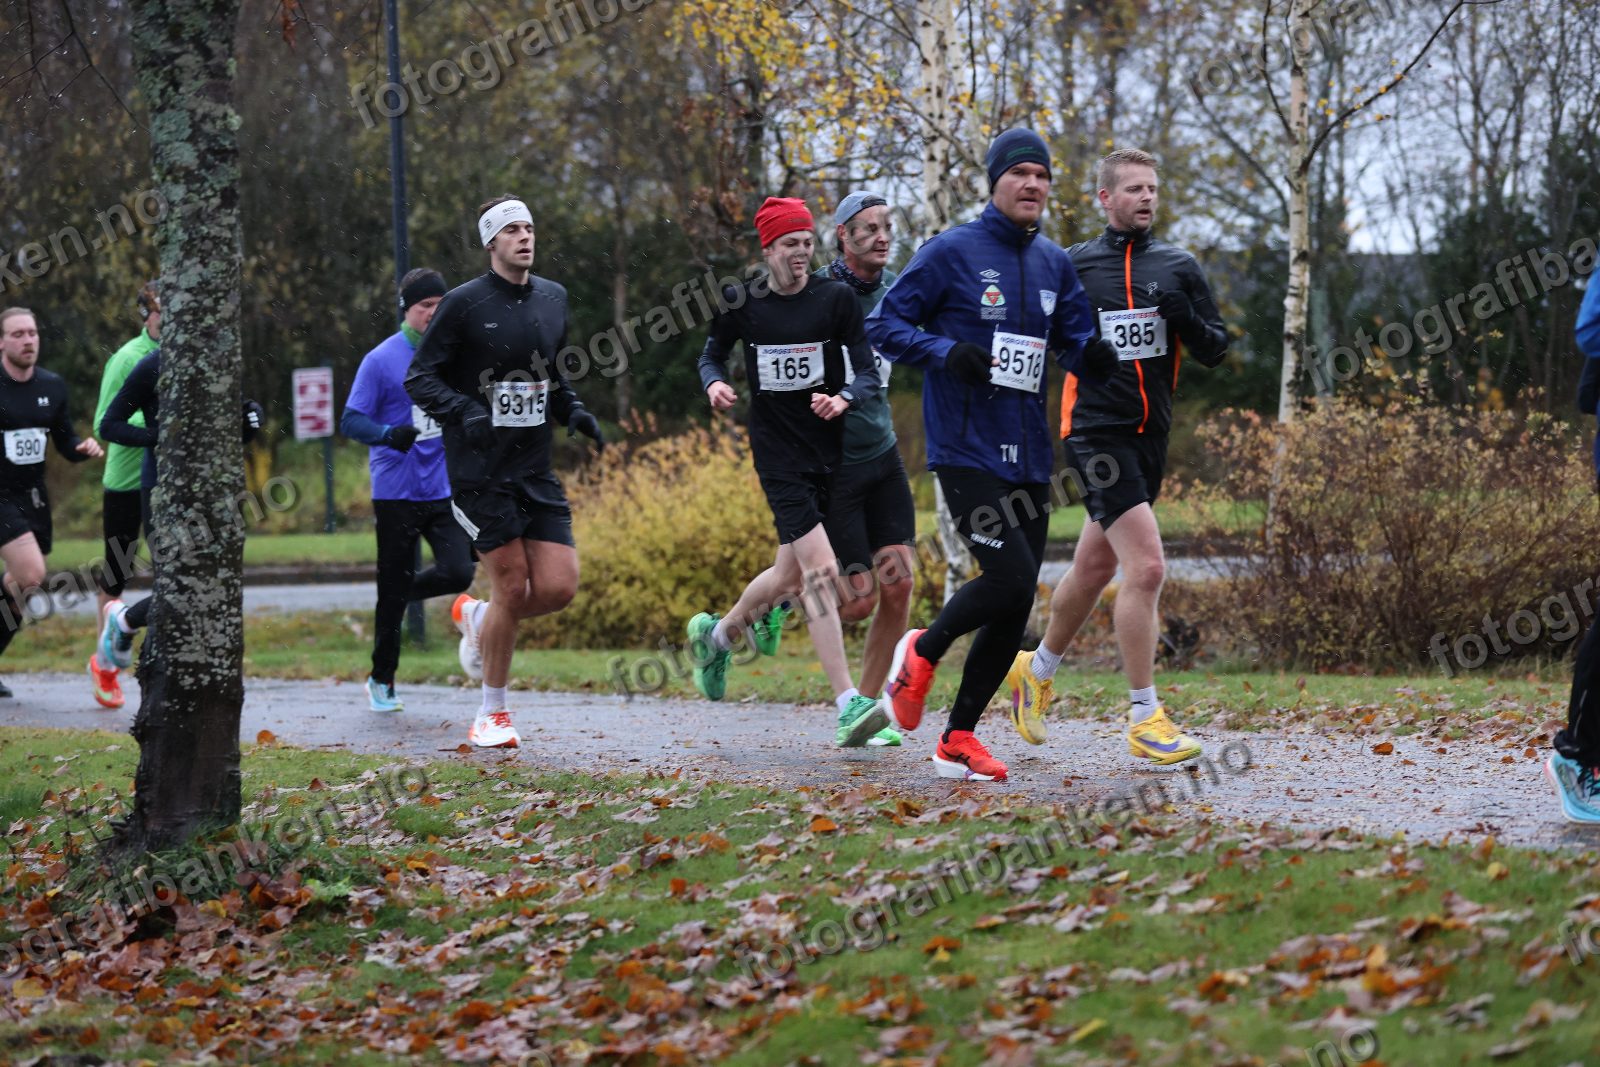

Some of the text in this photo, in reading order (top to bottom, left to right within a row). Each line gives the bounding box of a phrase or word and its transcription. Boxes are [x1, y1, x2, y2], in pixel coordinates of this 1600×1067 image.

[1114, 322, 1155, 348] 385
[771, 357, 810, 380] 165
[499, 393, 545, 415] 9315
[16, 439, 41, 457] 590
